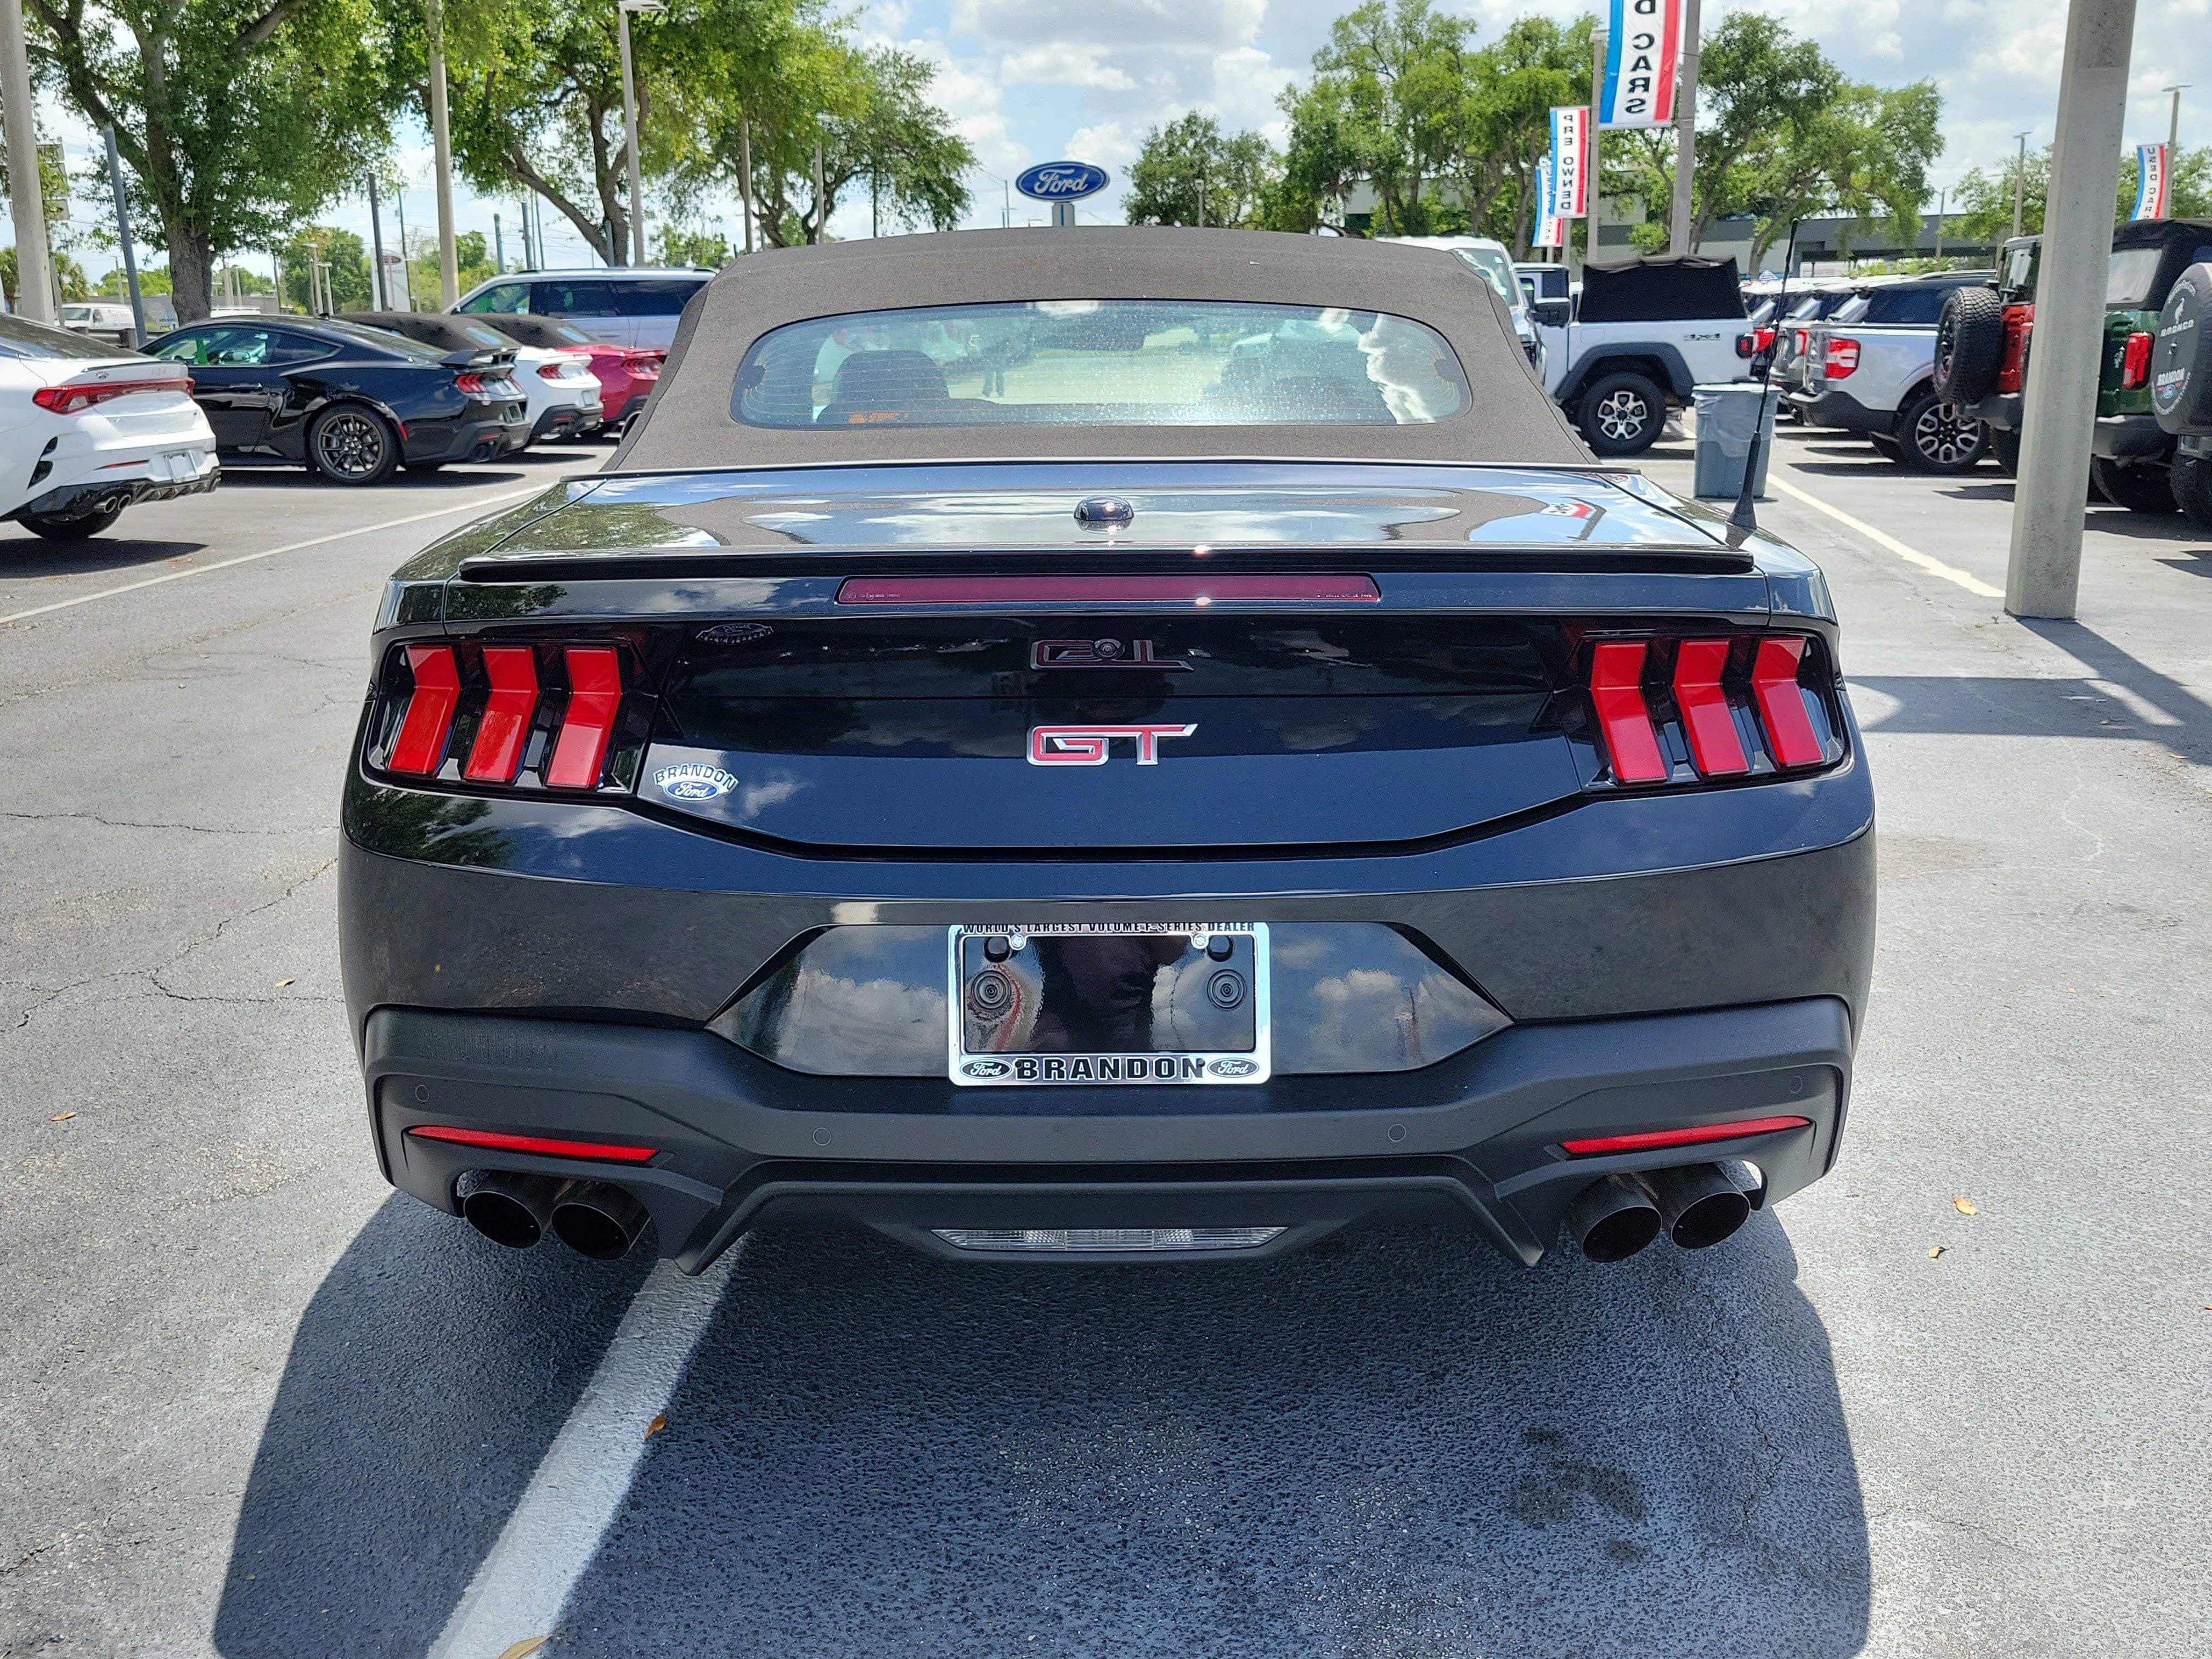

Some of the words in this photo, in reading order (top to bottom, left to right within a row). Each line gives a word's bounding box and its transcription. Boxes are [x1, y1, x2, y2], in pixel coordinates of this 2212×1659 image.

[1034, 168, 1088, 194] Ford
[1026, 723, 1198, 766] GT
[654, 764, 737, 792] BRANDON
[674, 781, 710, 798] Ford
[1208, 922, 1254, 931] DEALER
[970, 1063, 1001, 1076] Ford
[1014, 1057, 1205, 1081] BRANDON
[1217, 1060, 1248, 1074] Ford
